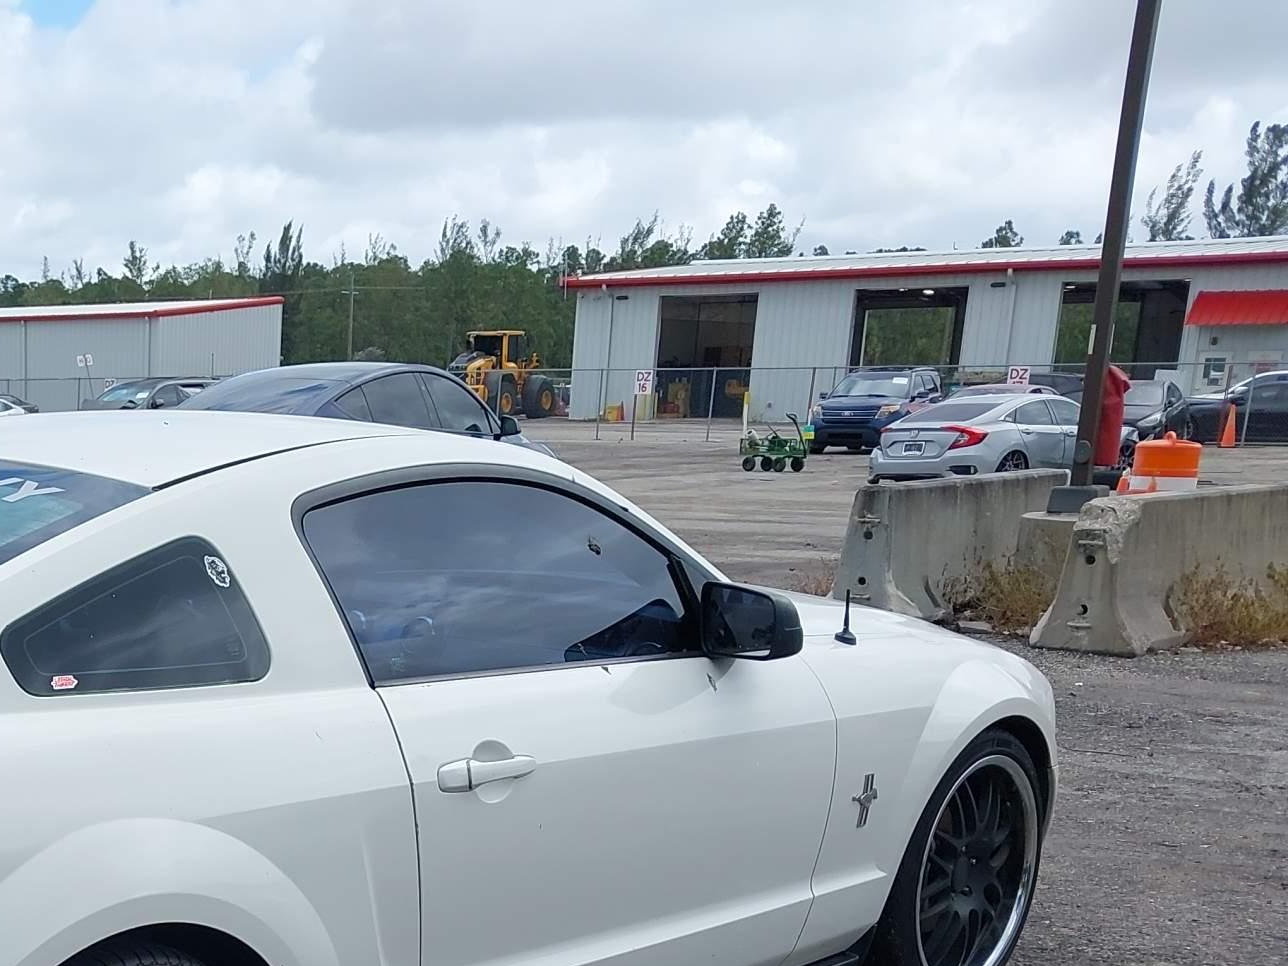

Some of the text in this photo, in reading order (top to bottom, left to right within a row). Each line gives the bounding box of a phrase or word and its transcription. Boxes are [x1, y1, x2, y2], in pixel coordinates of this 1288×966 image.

[637, 371, 652, 382] DZ
[1010, 368, 1029, 380] DZ
[638, 382, 648, 393] 16
